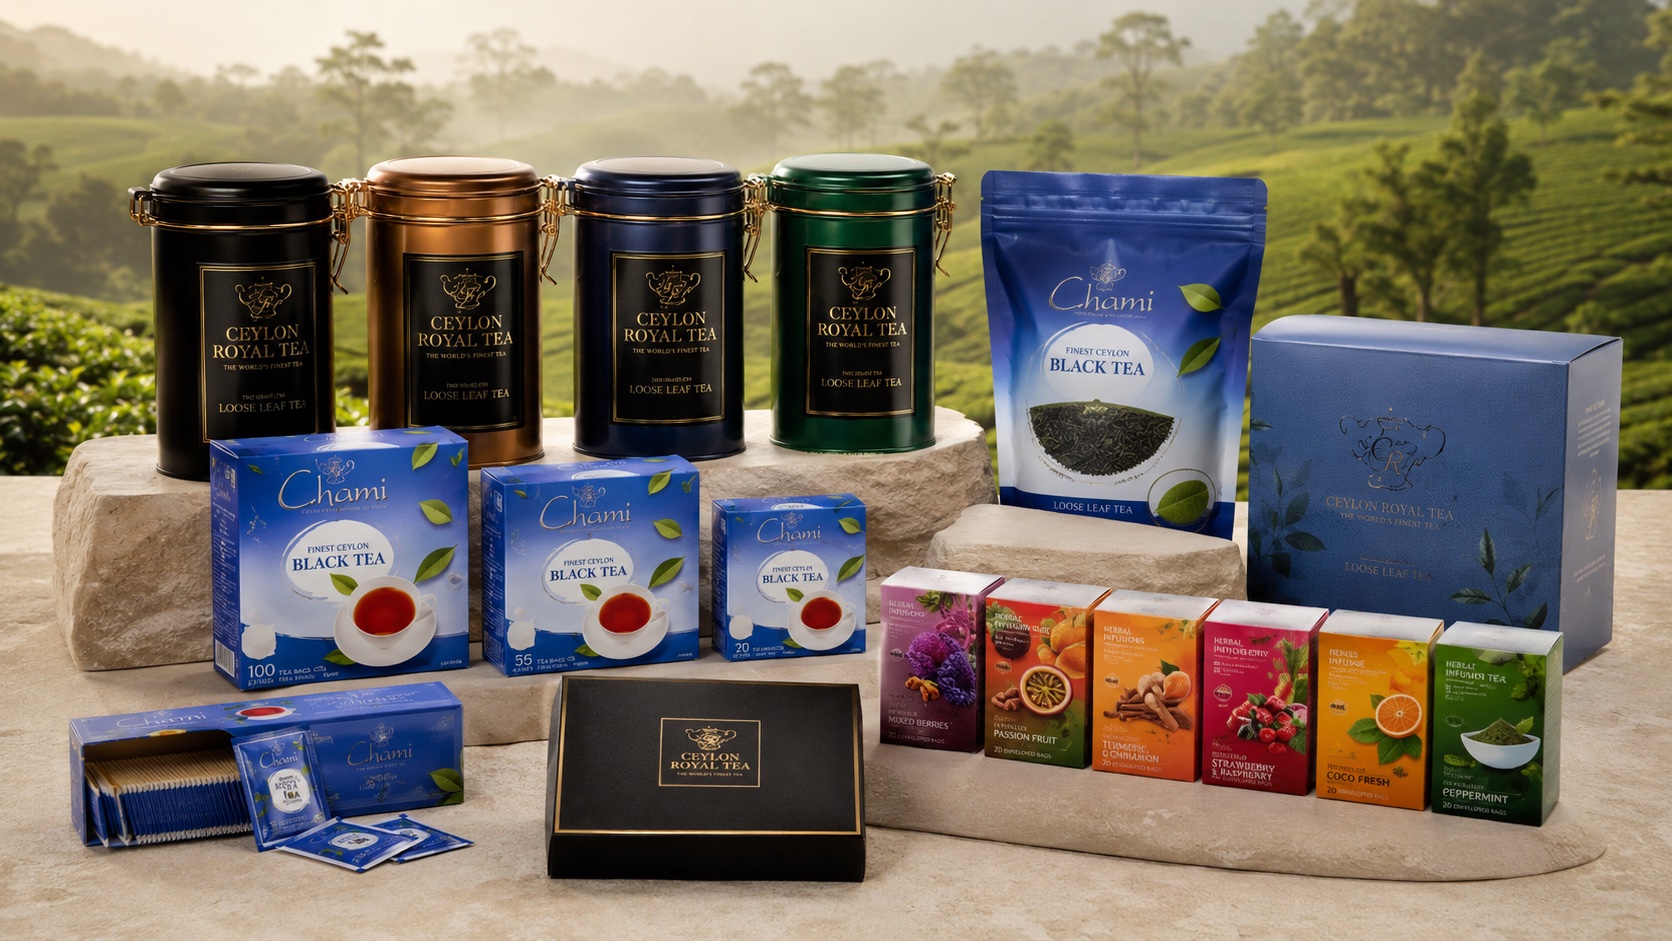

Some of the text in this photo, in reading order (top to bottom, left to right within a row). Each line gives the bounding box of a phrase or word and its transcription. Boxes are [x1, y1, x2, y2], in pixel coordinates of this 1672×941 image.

[1049, 276, 1154, 312] Chami
[637, 311, 706, 326] CEYLON
[829, 306, 897, 321] CEYLON
[430, 315, 503, 331] CEYLON
[817, 322, 907, 337] ROYAL TEA
[226, 324, 299, 341] CEYLON
[417, 331, 513, 347] ROYAL TEA
[624, 327, 717, 342] ROYAL TEA
[213, 341, 310, 359] ROYAL TEA
[1066, 347, 1129, 357] FINEST CEYLON
[1050, 358, 1145, 375] BLACK TEA
[630, 384, 712, 394] LOOSE LEAF TEA
[822, 378, 901, 388] LOOSE LEAF TEA
[424, 389, 509, 400] LOOSE LEAF TEA
[219, 400, 307, 413] LOOSE LEAF TEA
[278, 469, 388, 510] Chami
[539, 495, 631, 530] Chami
[1053, 501, 1133, 514] LOOSE LEAF TEA
[1326, 496, 1454, 521] CEYLON ROYAL TEA
[757, 517, 821, 543] Chami
[308, 542, 369, 553] FINEST CEYLON
[292, 552, 386, 571] BLACK TEA
[550, 566, 627, 581] BLACK TEA
[762, 573, 823, 584] BLACK TEA
[1345, 562, 1432, 582] LOOSE LEAF TEA
[735, 643, 749, 653] 20
[248, 664, 275, 678] 100
[888, 716, 949, 729] MIXED BERRIES
[994, 730, 1057, 744] PASSION FRUIT
[347, 741, 413, 767] Chami
[681, 752, 739, 761] CEYLON
[671, 762, 750, 770] ROYAL TEA
[1327, 771, 1390, 786] COCO FRESH
[1327, 786, 1336, 794] 20
